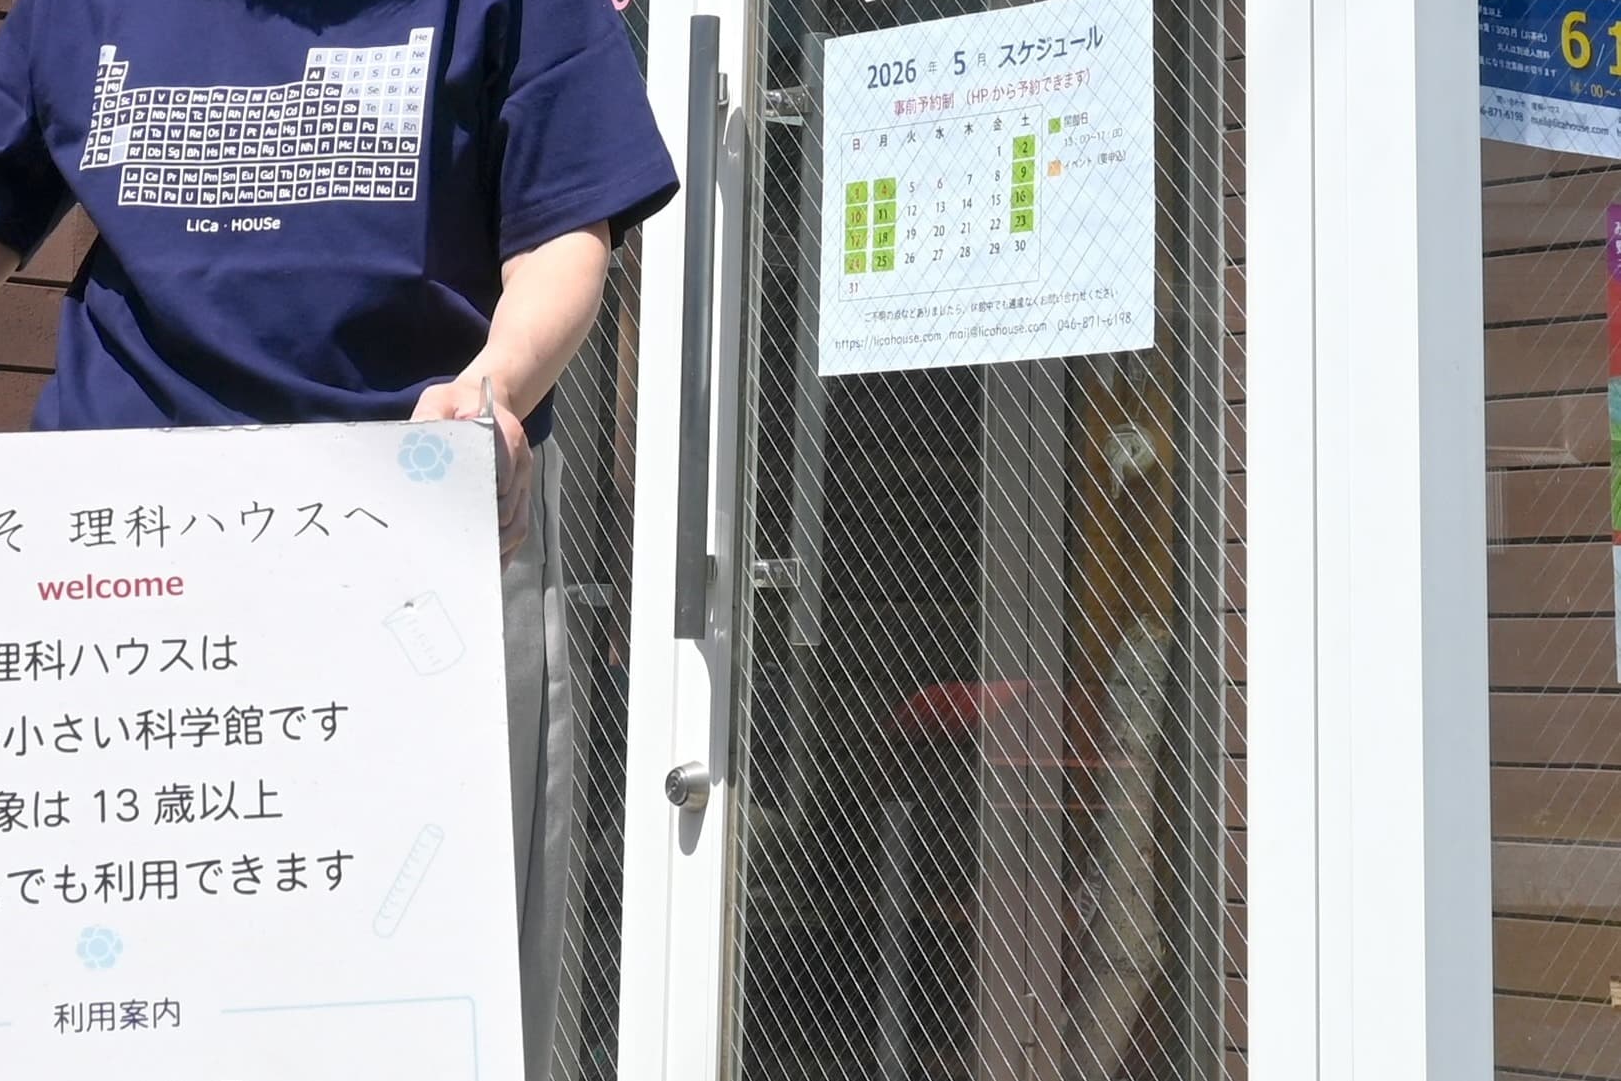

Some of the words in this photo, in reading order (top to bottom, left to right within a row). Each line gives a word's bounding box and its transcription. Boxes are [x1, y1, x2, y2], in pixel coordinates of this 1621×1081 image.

[867, 58, 917, 89] 2026
[928, 60, 938, 74] 年
[954, 50, 966, 76] 5
[977, 52, 986, 67] 月
[998, 25, 1104, 68] スケジュール
[893, 92, 955, 116] 事前予約制
[853, 138, 861, 151] 日
[879, 134, 888, 147] 月
[907, 130, 916, 144] 火
[935, 126, 944, 140] 水
[964, 122, 973, 135] 木
[993, 116, 1003, 131] 金
[1021, 114, 1031, 127] 土
[851, 211, 861, 223] 10
[879, 209, 888, 220] 11
[907, 205, 917, 217] 12
[936, 202, 946, 213] 13
[963, 198, 972, 209] 14
[991, 194, 1001, 206] 15
[1016, 190, 1026, 202] 16
[186, 219, 219, 233] LiCa
[231, 216, 281, 232] HOUSe
[879, 232, 888, 244] 18
[906, 229, 916, 240] 19
[934, 225, 945, 237] 20
[961, 222, 971, 234] 21
[990, 218, 1001, 230] 22
[1015, 215, 1026, 228] 23
[877, 255, 887, 267] 25
[905, 253, 915, 264] 26
[933, 249, 943, 261] 27
[960, 246, 971, 258] 28
[989, 243, 1000, 255] 29
[1015, 240, 1026, 251] 30
[849, 282, 859, 293] 31
[69, 498, 389, 552] 理科ハウスへ
[37, 573, 184, 601] welcome
[54, 997, 180, 1033] 利用案内
